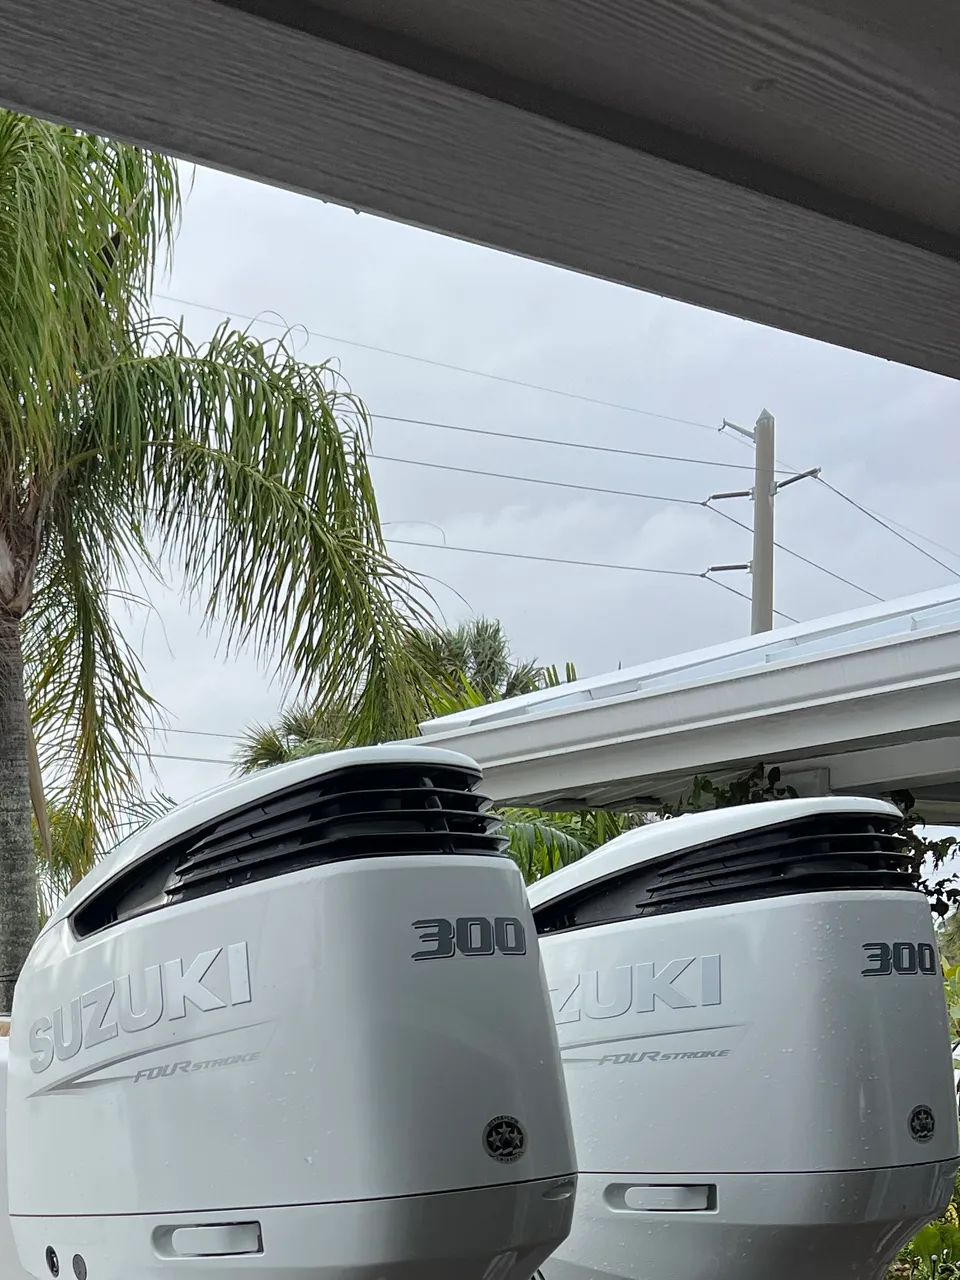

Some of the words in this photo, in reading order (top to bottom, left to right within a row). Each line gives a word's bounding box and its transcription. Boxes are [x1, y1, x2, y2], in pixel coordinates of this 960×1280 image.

[411, 917, 526, 961] 300
[861, 942, 936, 977] 300
[29, 941, 252, 1074] SUZUKI
[549, 953, 722, 1026] ZUKI
[133, 1060, 192, 1084] FOUR
[191, 1051, 263, 1073] STROKE
[598, 1050, 661, 1066] FOUR
[659, 1049, 732, 1062] STROKE
